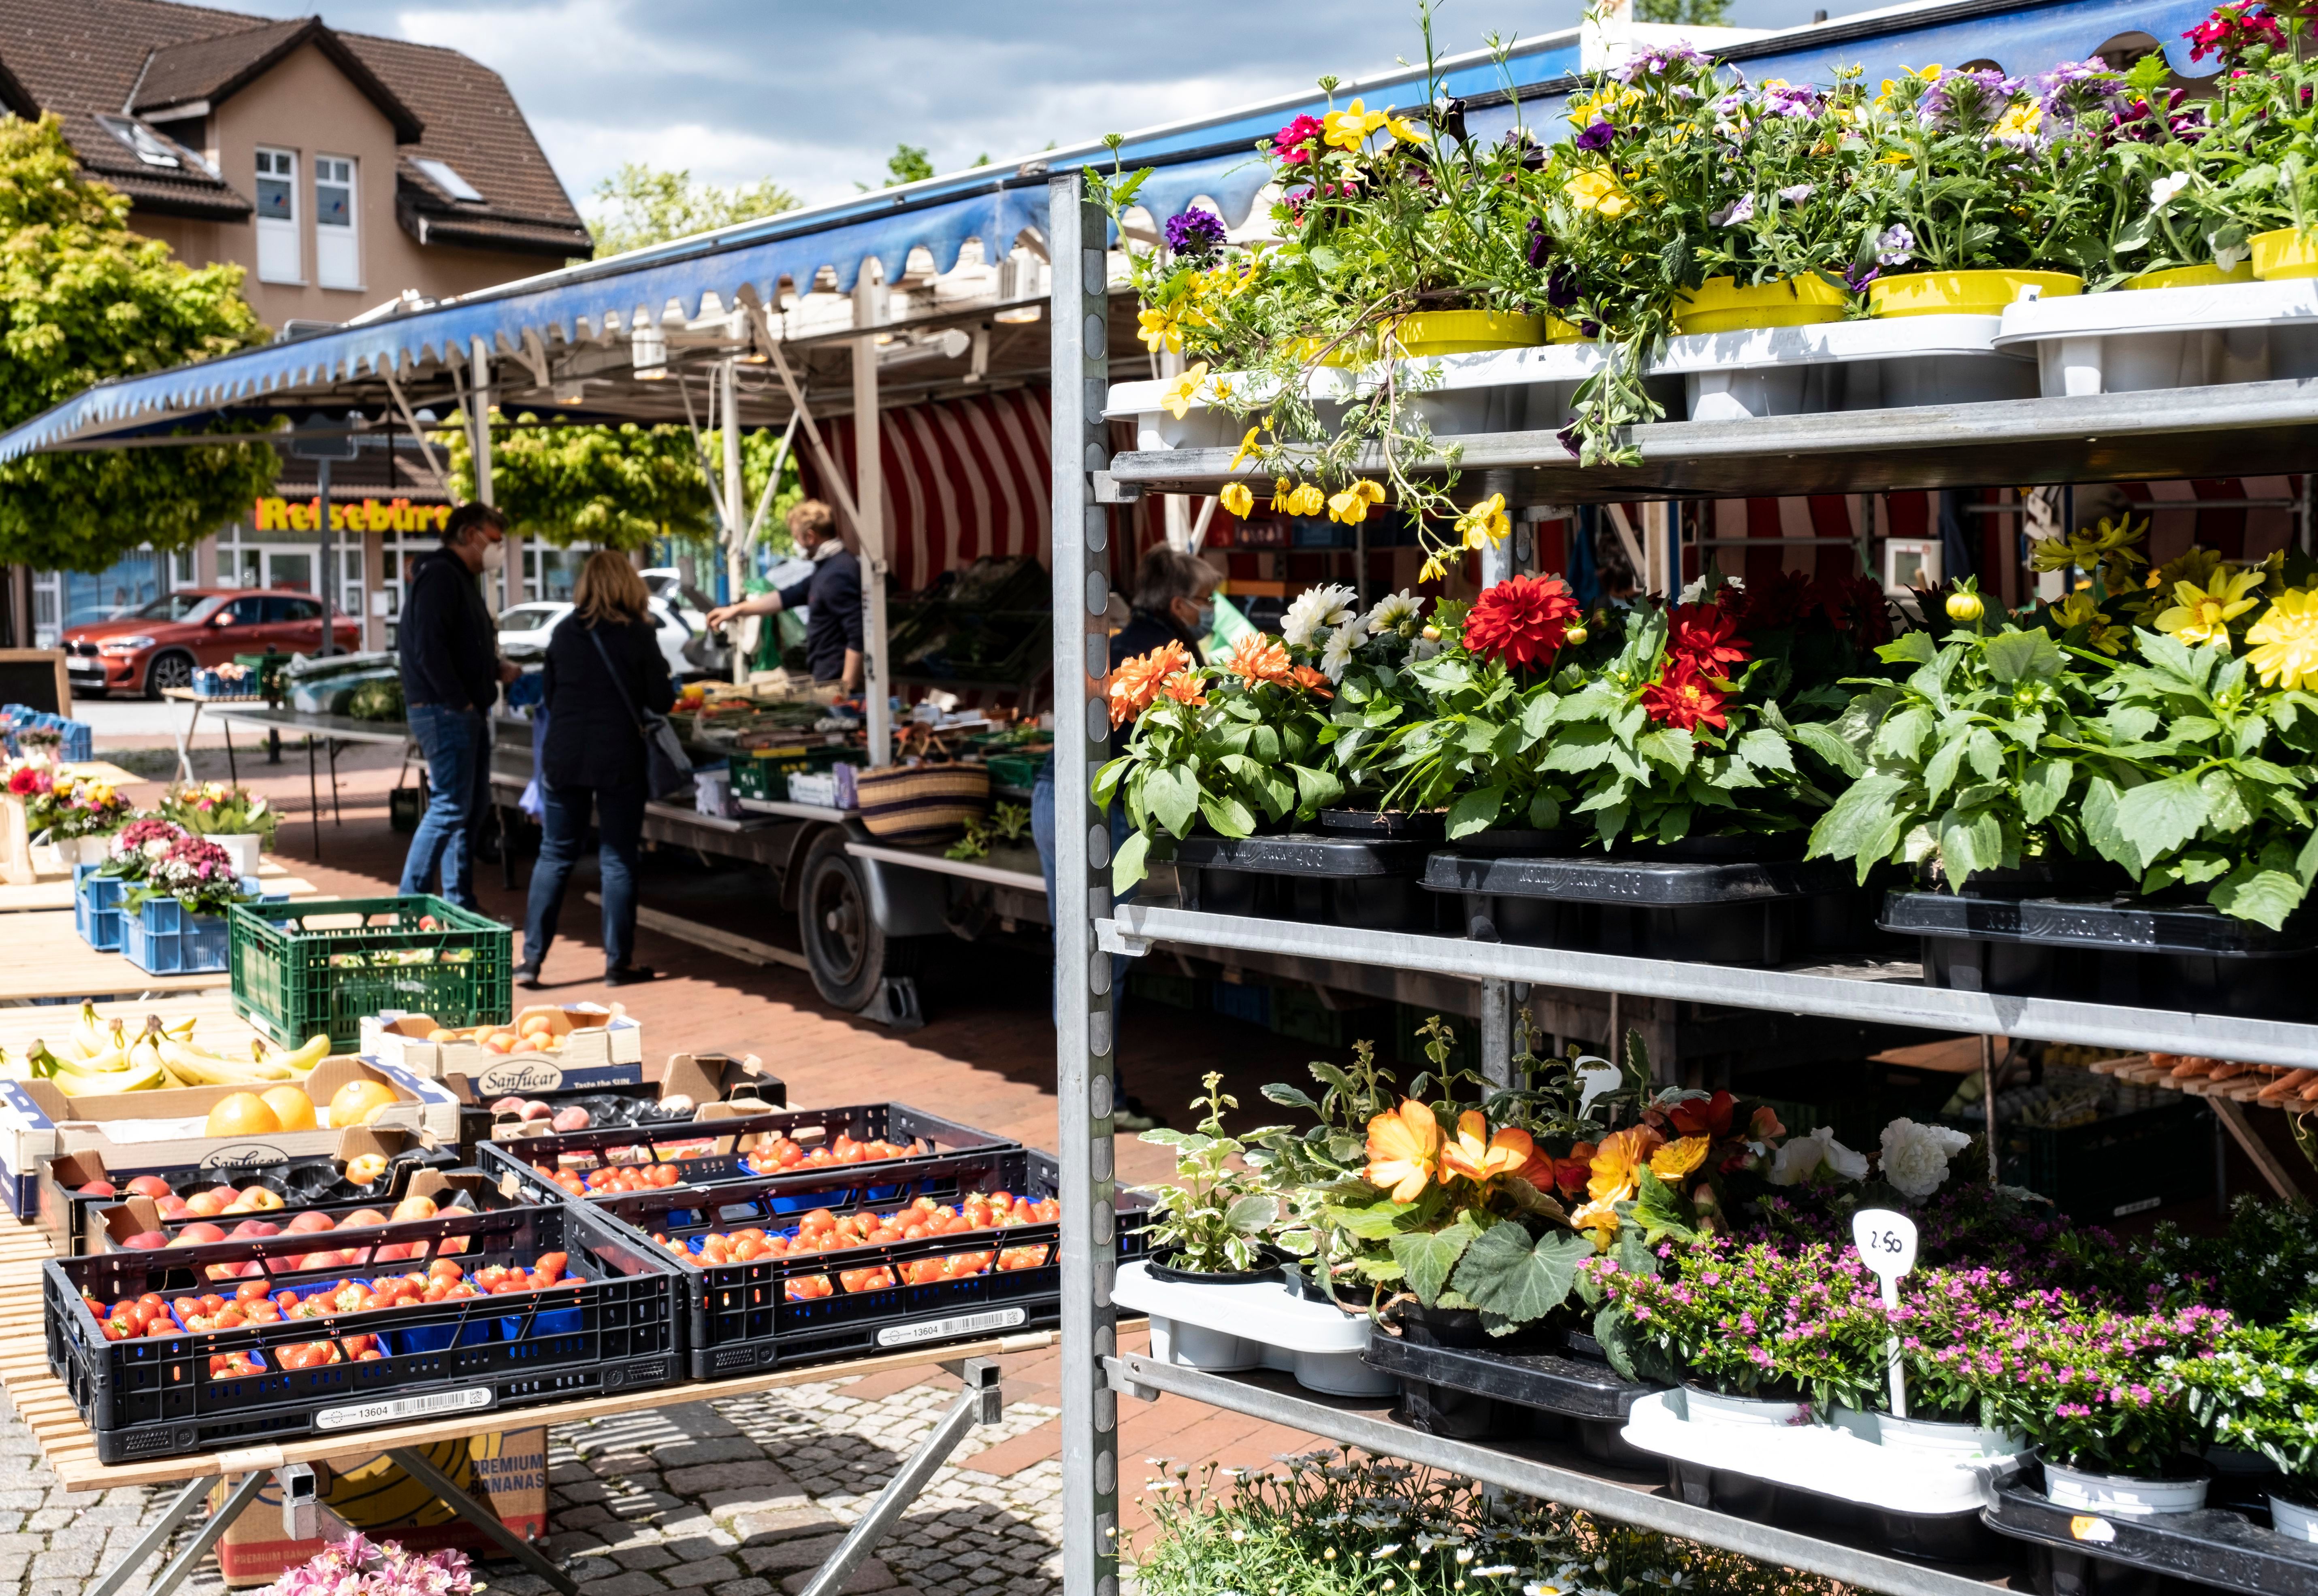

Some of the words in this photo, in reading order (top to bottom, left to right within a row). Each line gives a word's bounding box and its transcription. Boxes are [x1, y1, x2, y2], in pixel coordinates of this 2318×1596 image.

[1296, 844, 1323, 867] 408
[1609, 871, 1641, 895] 408
[486, 1066, 557, 1094] SanLucar
[1871, 1230, 1902, 1253] 2.50
[914, 1326, 938, 1336] 13604
[359, 1407, 388, 1417] 13604
[470, 1454, 543, 1476] PREMIUM
[470, 1473, 545, 1495] BANANAS
[233, 1551, 281, 1565] PREMIUM
